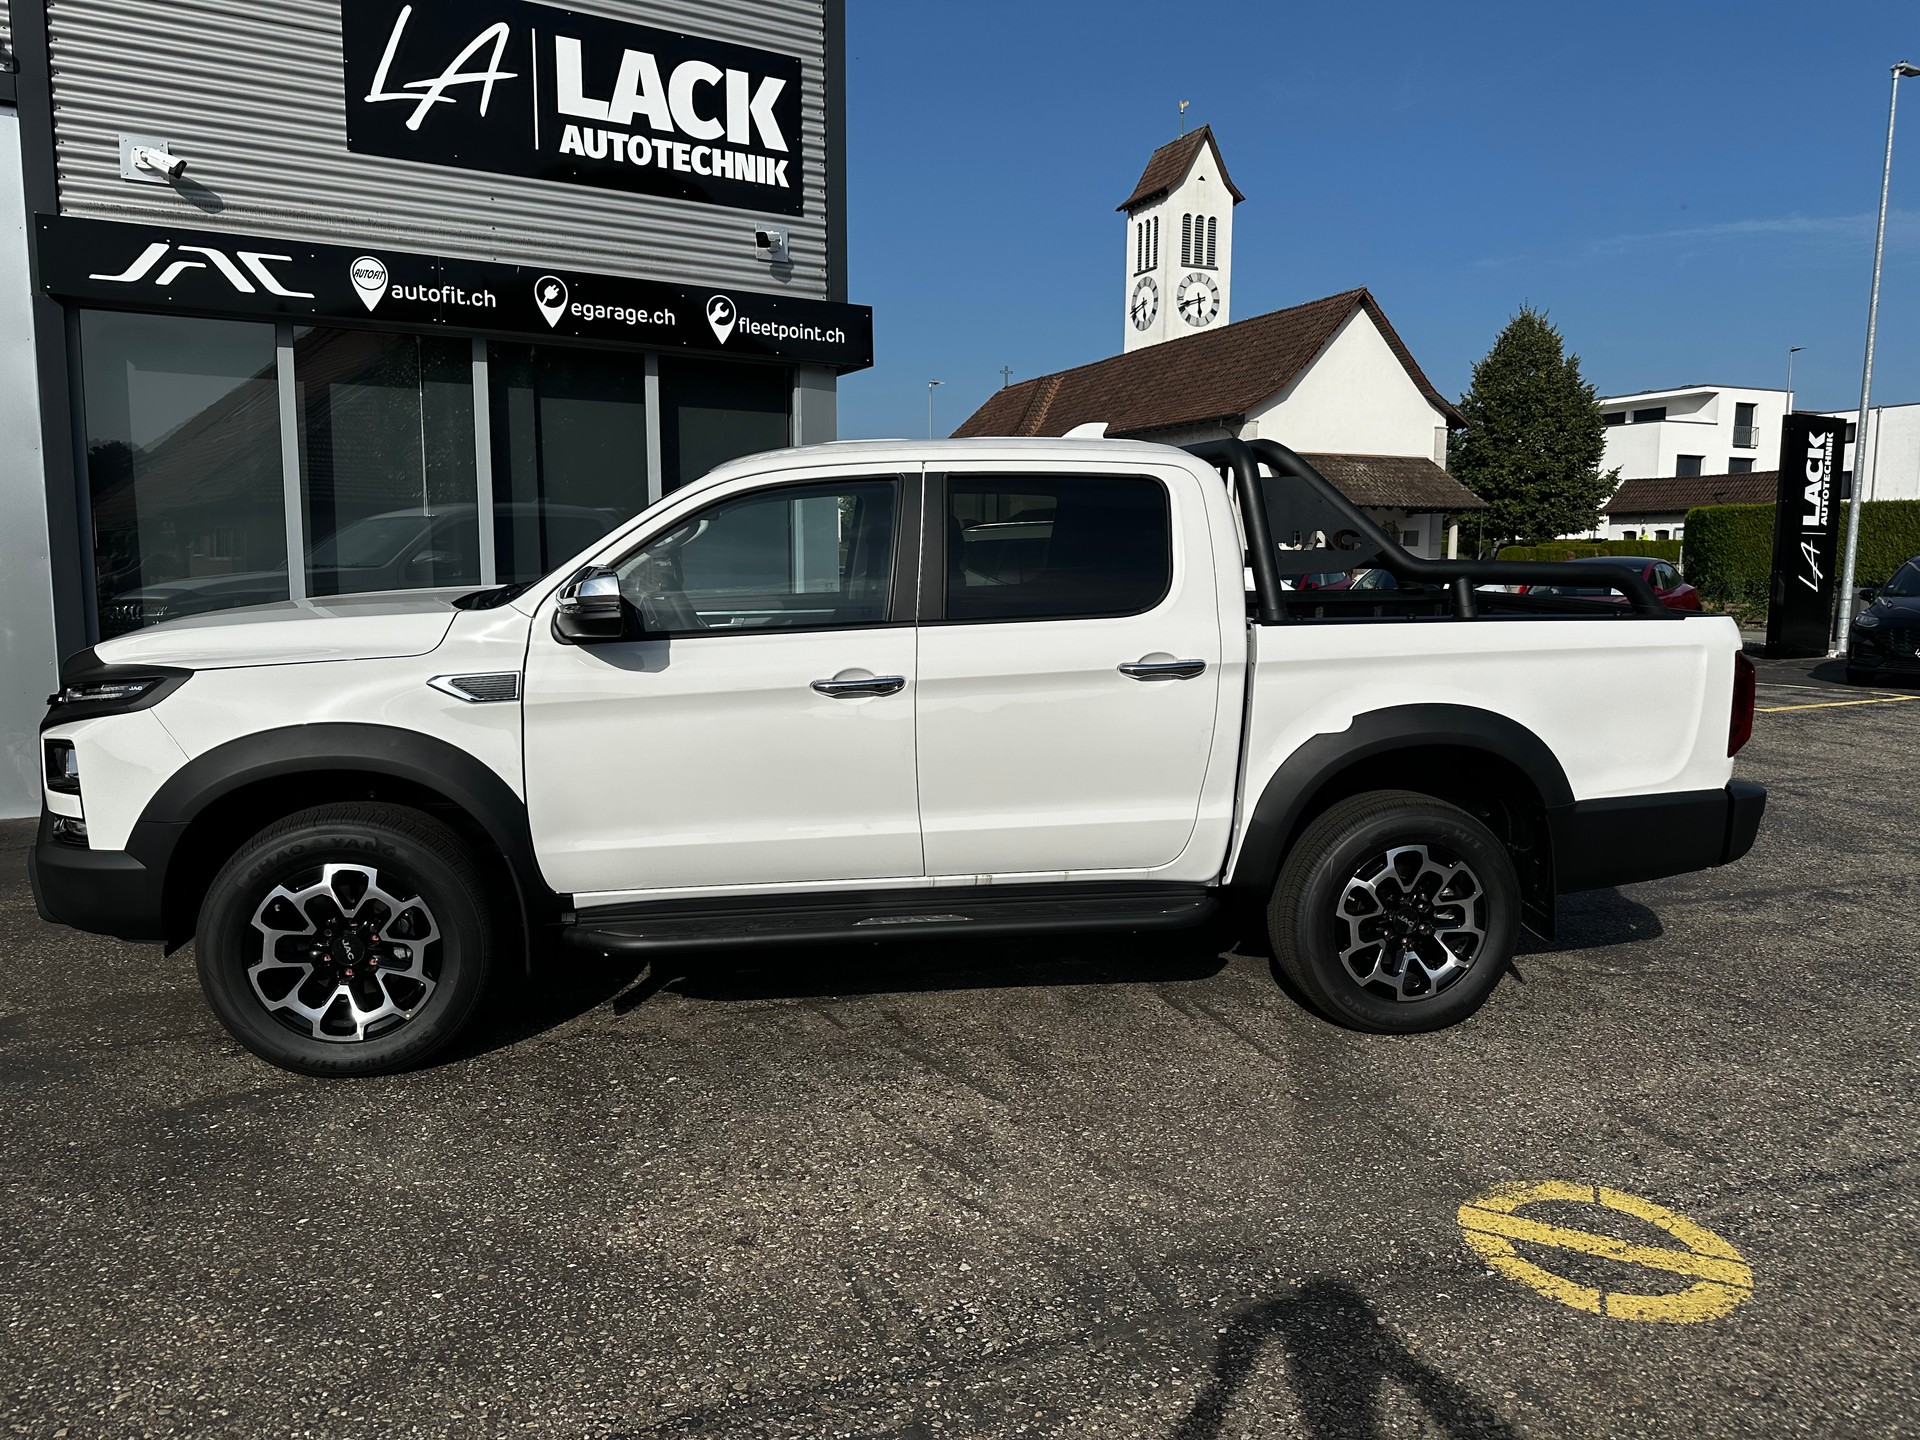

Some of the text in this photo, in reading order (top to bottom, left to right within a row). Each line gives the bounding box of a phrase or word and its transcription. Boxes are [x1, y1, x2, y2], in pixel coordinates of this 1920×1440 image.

[364, 4, 518, 131] LA
[555, 34, 789, 153] LACK
[558, 124, 790, 189] AUTOTECHNIK
[88, 242, 315, 299] JAC
[354, 268, 385, 280] AUTOFIT
[391, 284, 496, 308] autofit.ch
[571, 302, 676, 326] egarage.ch
[738, 315, 845, 345] fleetpoint.ch
[1801, 430, 1827, 527] LACK
[1820, 431, 1834, 526] AUTOTECHNIK
[1278, 529, 1362, 551] JAC
[341, 938, 355, 961] JAC
